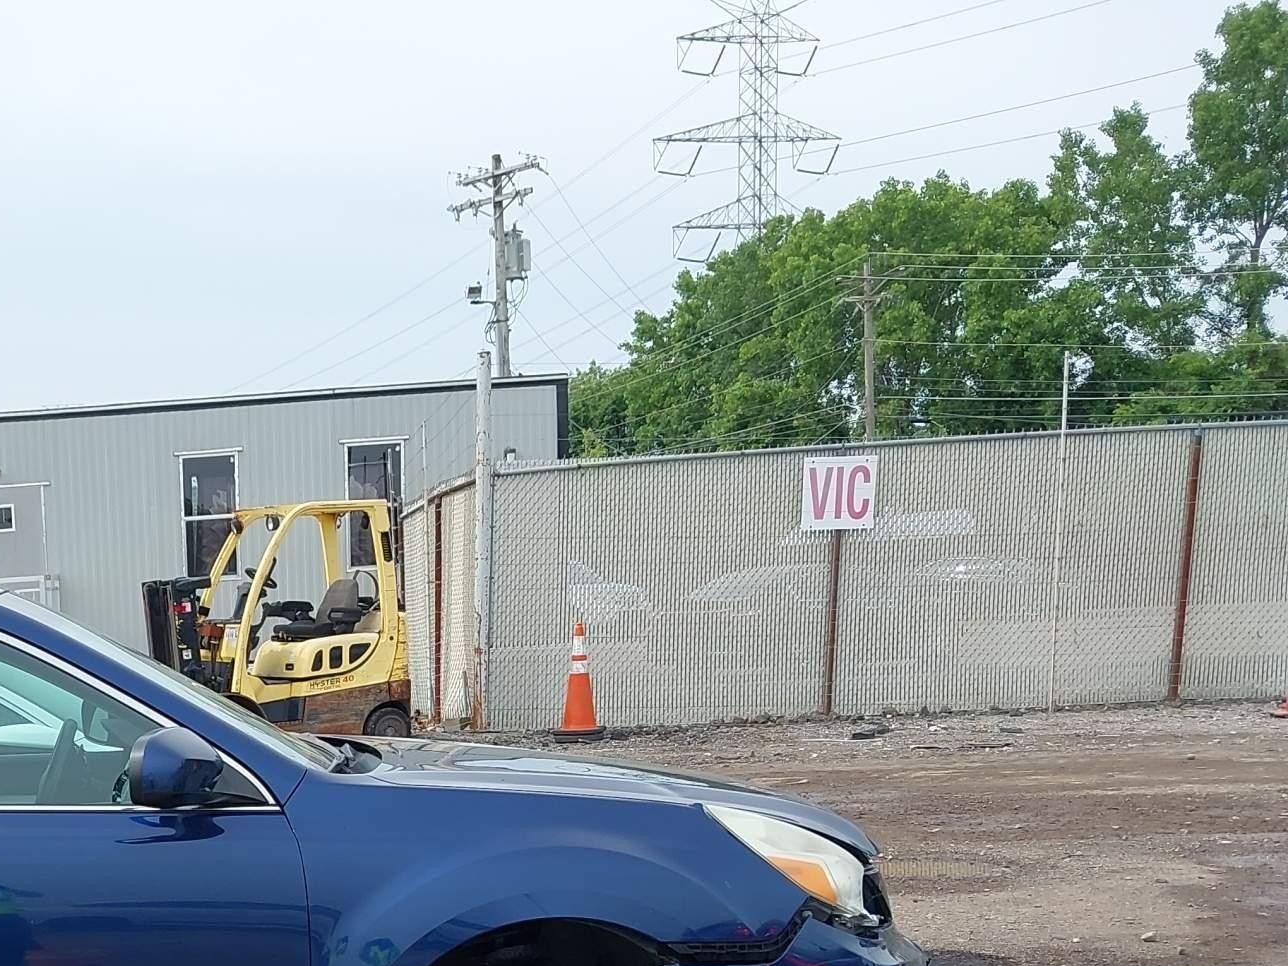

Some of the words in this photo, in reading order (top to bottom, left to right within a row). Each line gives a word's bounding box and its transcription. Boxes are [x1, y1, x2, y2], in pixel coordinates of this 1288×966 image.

[808, 464, 871, 521] VIC
[309, 677, 341, 690] HYSTER
[342, 674, 355, 683] 40
